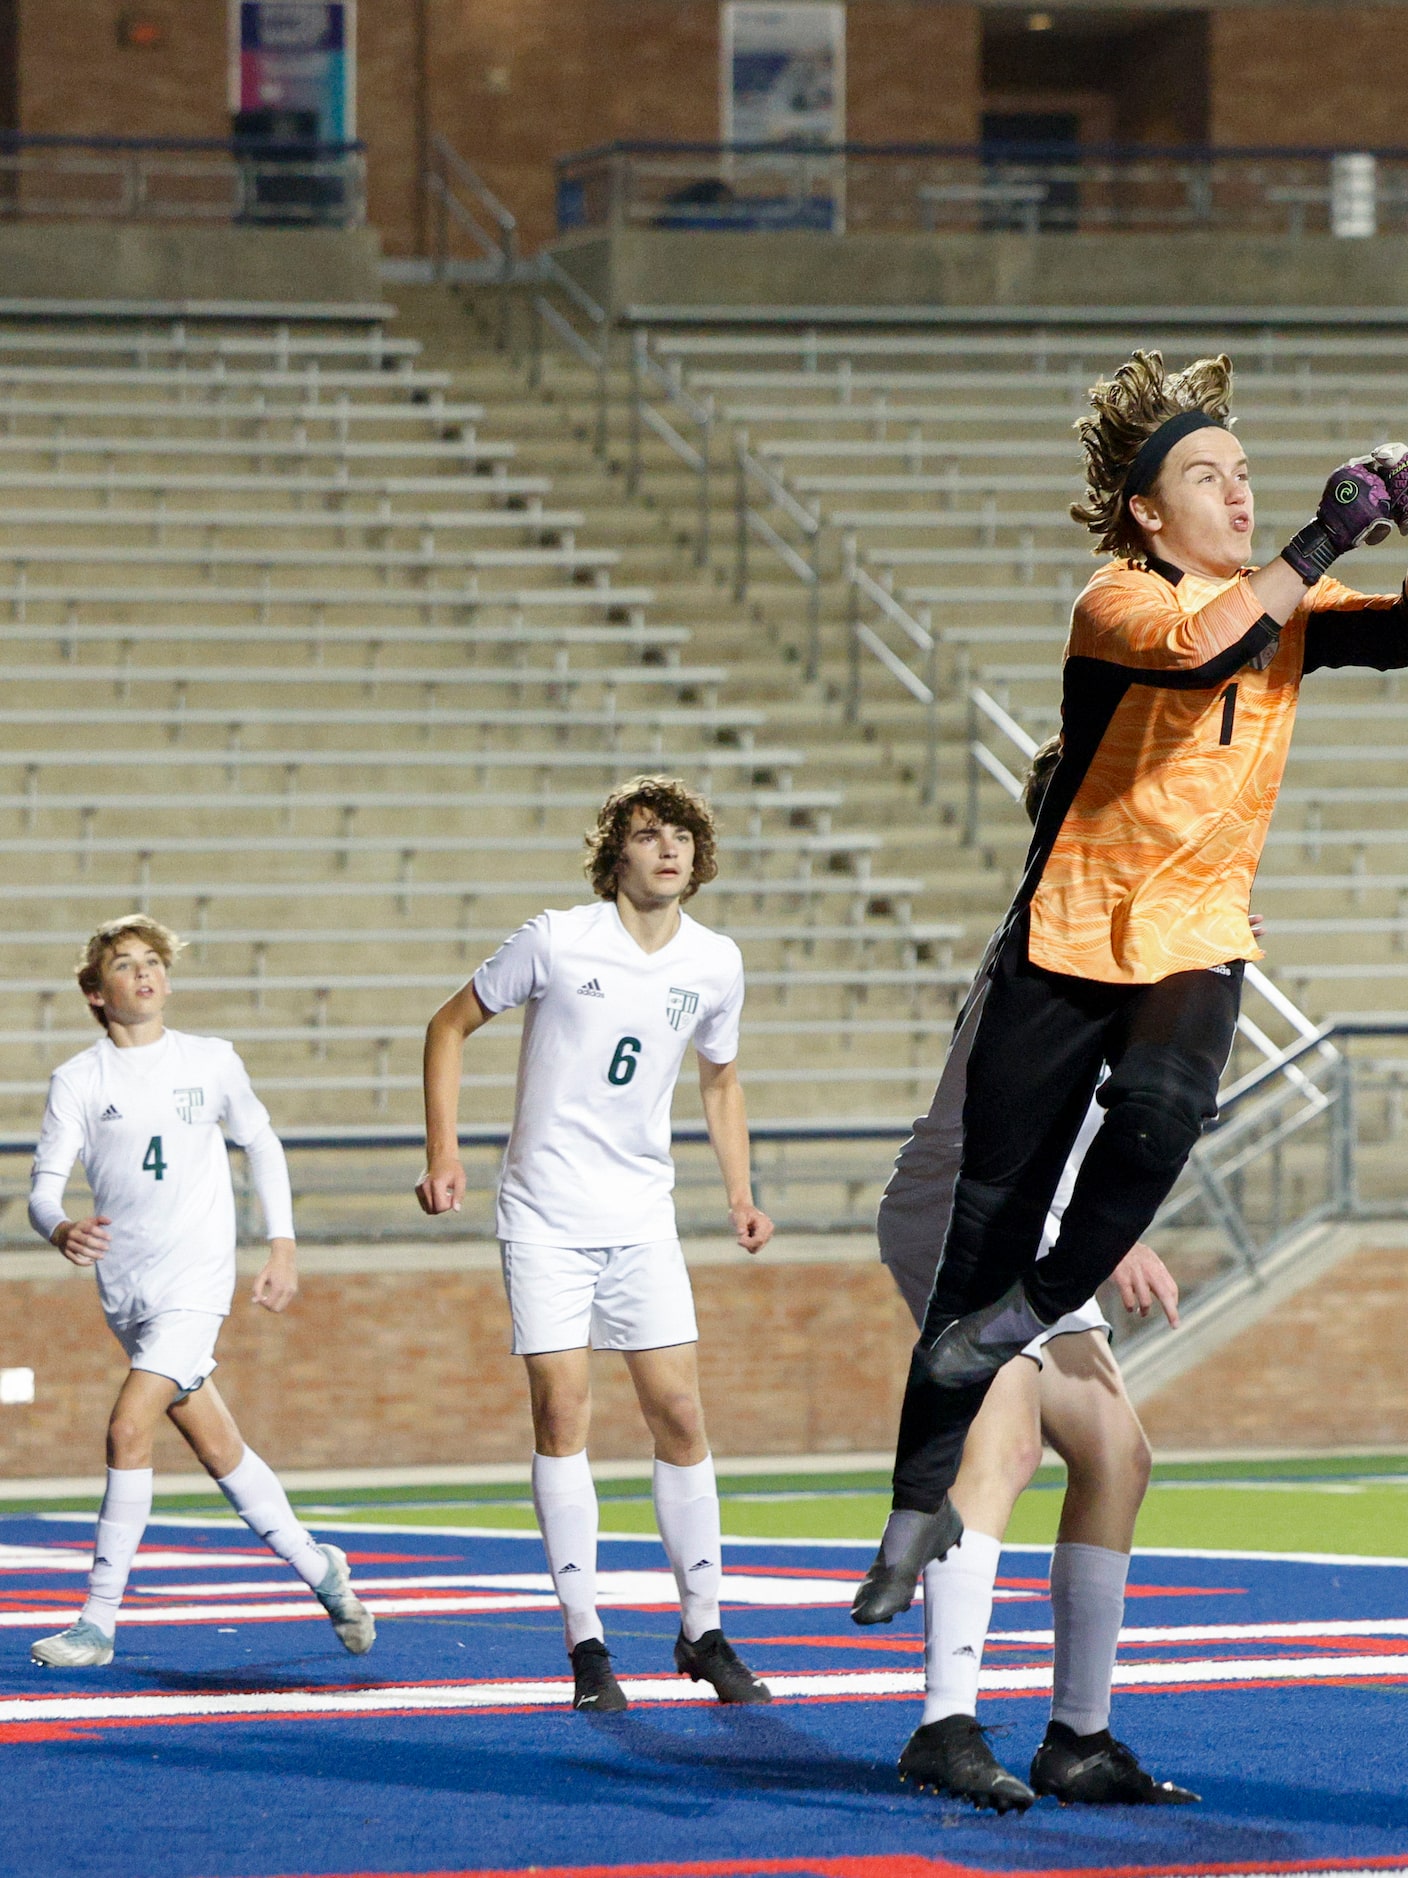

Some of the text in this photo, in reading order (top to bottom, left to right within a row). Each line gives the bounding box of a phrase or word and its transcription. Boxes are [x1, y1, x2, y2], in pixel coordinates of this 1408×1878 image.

[1219, 682, 1239, 746] 1
[577, 988, 605, 998] adidas
[607, 1036, 642, 1086] 6
[142, 1135, 168, 1181] 4
